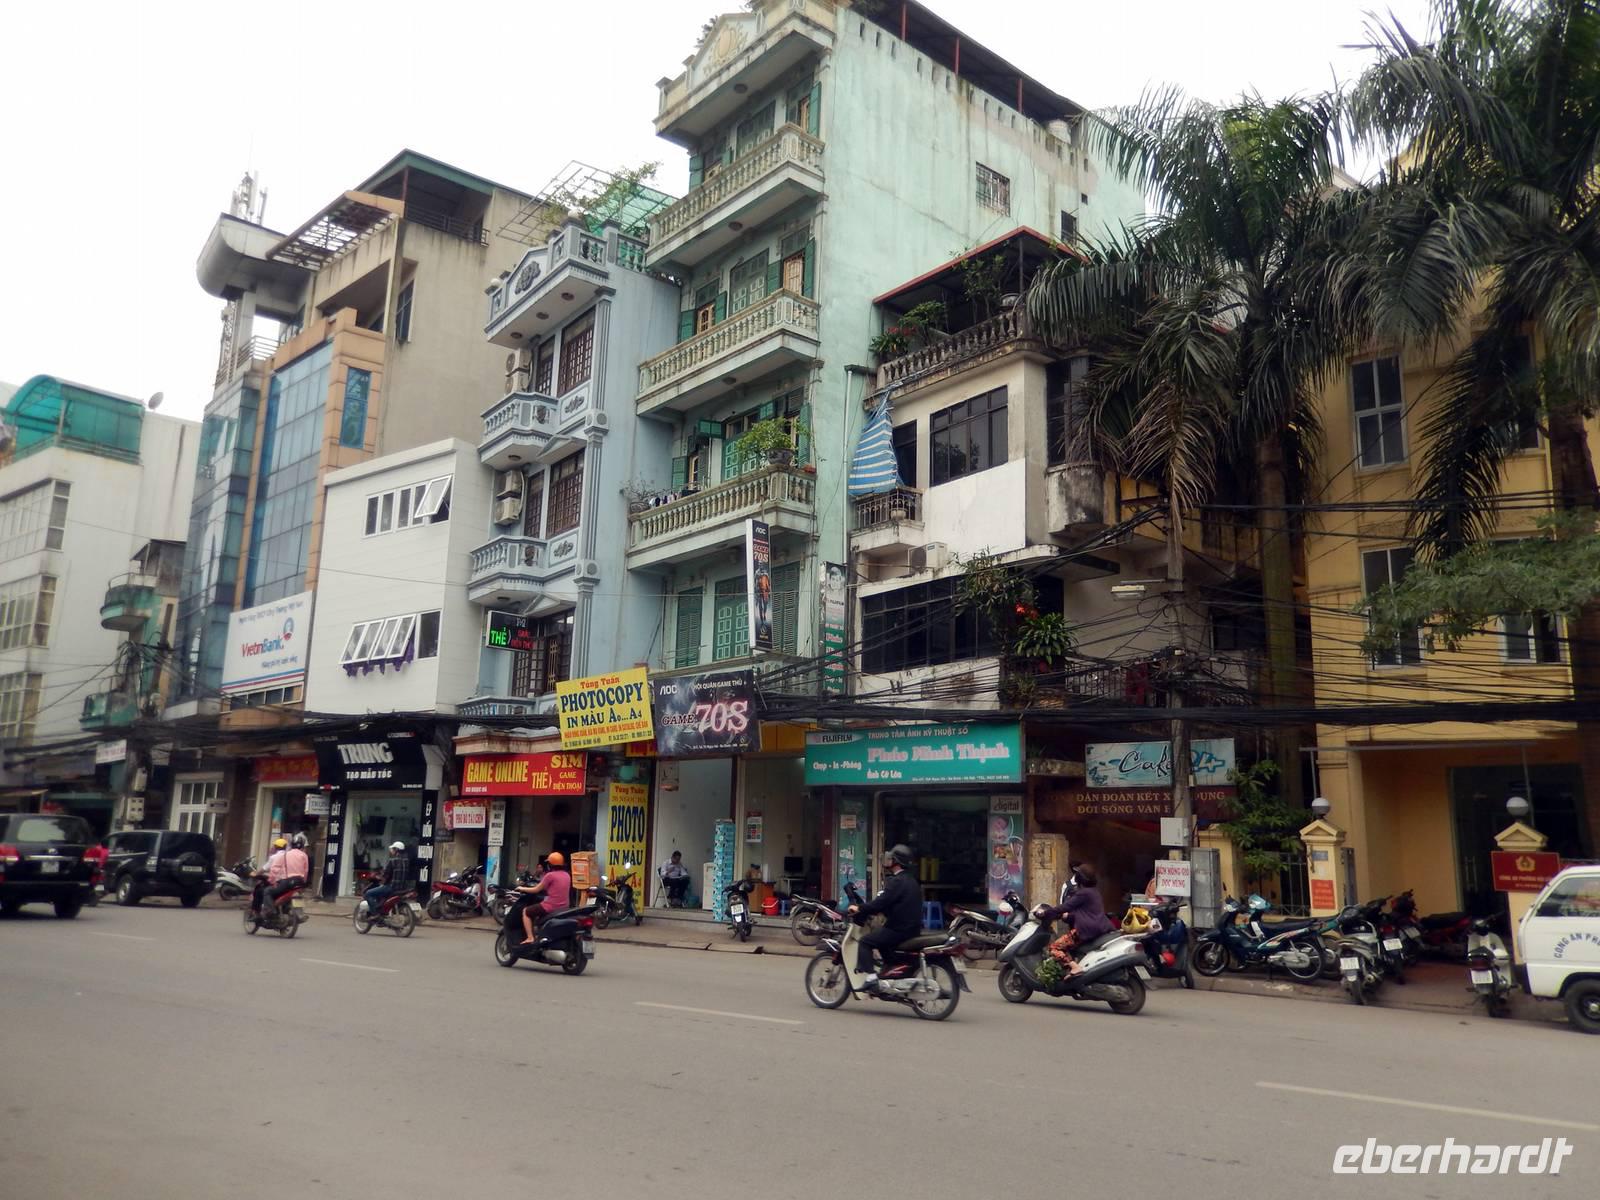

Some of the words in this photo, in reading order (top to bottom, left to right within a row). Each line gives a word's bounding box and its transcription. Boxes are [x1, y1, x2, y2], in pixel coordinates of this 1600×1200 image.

[490, 626, 507, 646] THẺ
[241, 636, 283, 657] VietinBank
[560, 682, 643, 713] PHOTOCOPY
[567, 716, 578, 728] IN
[580, 710, 604, 727] MÀU
[661, 714, 695, 726] GAME
[695, 700, 749, 734] 70S
[822, 734, 853, 743] FUJIFILM
[891, 730, 906, 738] TÂM
[934, 728, 956, 737] THUẬT
[337, 742, 394, 764] TRUNG
[551, 754, 583, 769] SIM
[467, 762, 494, 783] GAME
[495, 761, 529, 783] ONLINE
[532, 766, 549, 789] THẺ
[560, 771, 577, 779] GAME
[610, 805, 645, 843] PHOTO
[609, 850, 620, 865] IN
